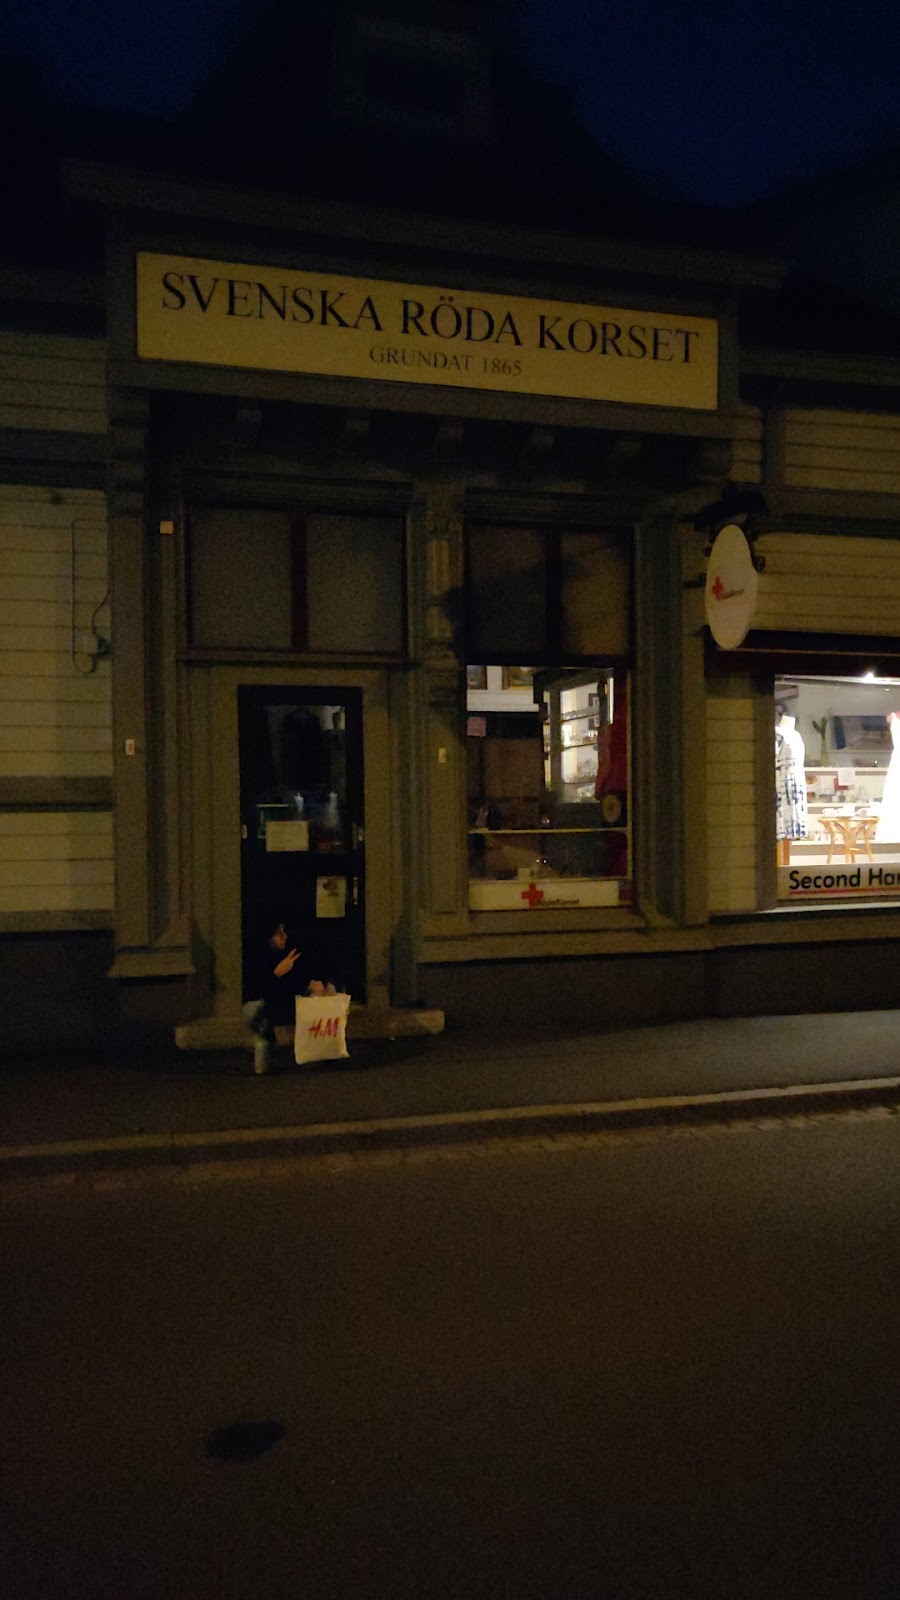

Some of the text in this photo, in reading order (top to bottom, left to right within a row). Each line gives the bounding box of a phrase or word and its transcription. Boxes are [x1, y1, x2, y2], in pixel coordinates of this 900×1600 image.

[161, 271, 700, 364] SVENSKA RÖDA KORSET
[368, 345, 522, 377] GRUNDAT 1865
[789, 867, 861, 890] Second
